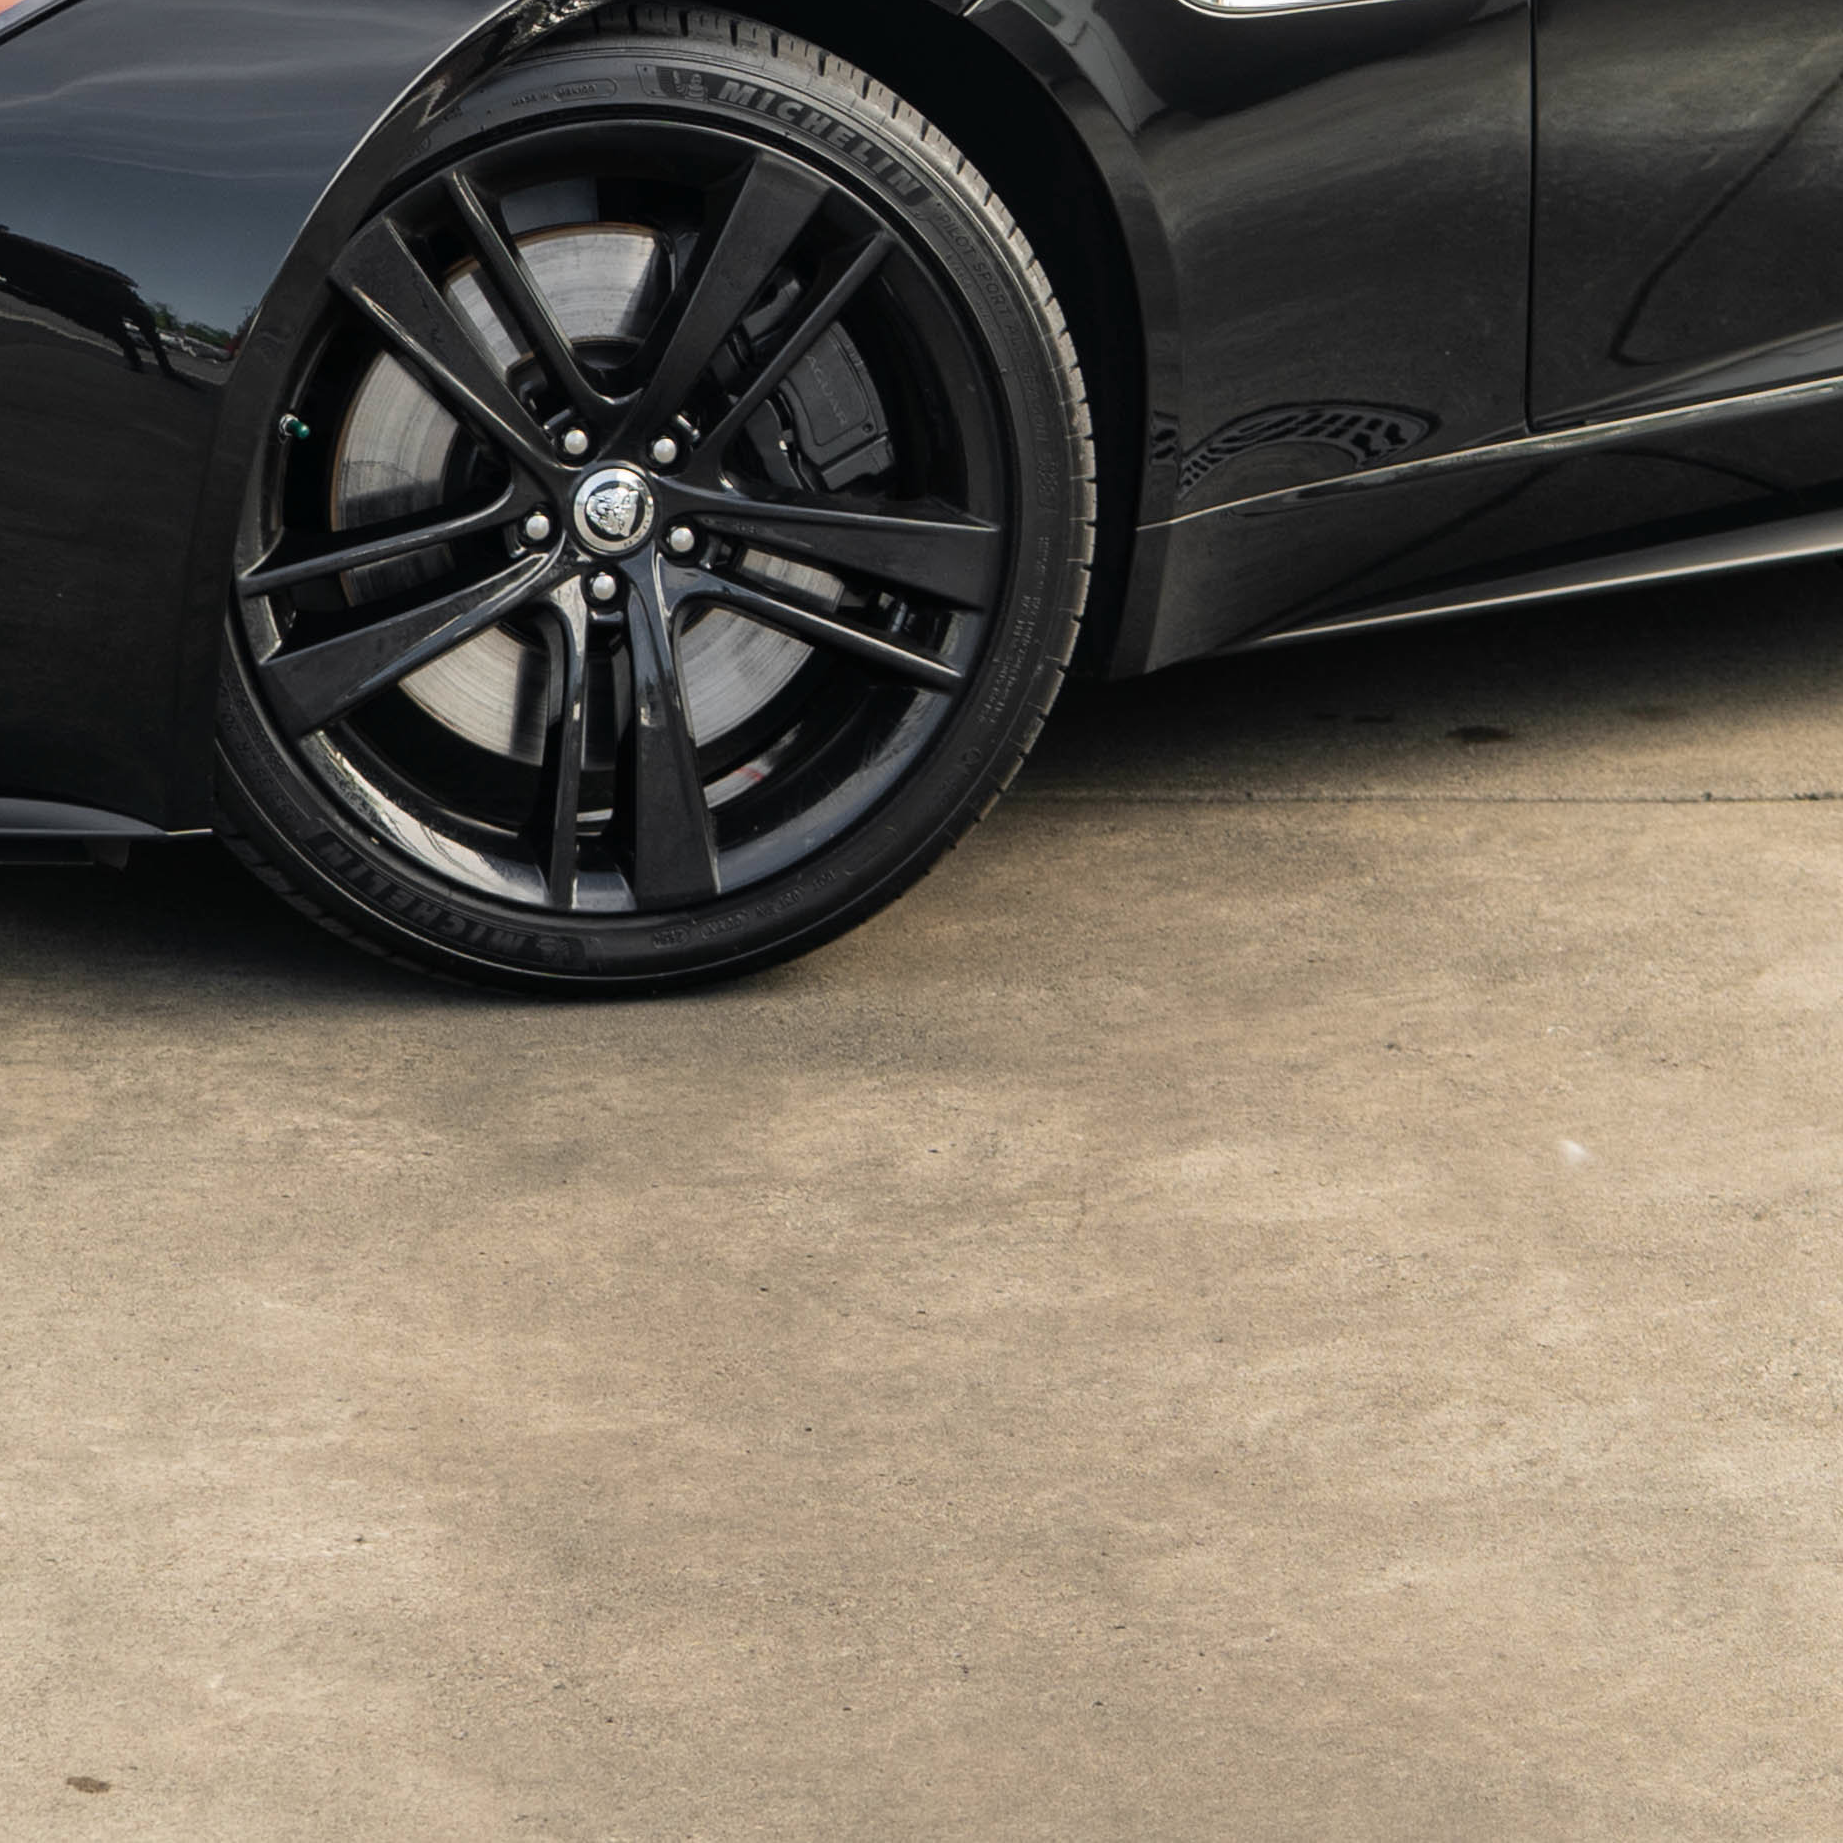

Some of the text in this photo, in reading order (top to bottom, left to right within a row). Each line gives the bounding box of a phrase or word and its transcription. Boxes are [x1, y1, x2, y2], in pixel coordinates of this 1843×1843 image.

[717, 79, 923, 198] MICHELIN
[940, 210, 975, 257] PILOT
[973, 260, 1012, 321] SPORT
[318, 838, 527, 955] MICHELIN
